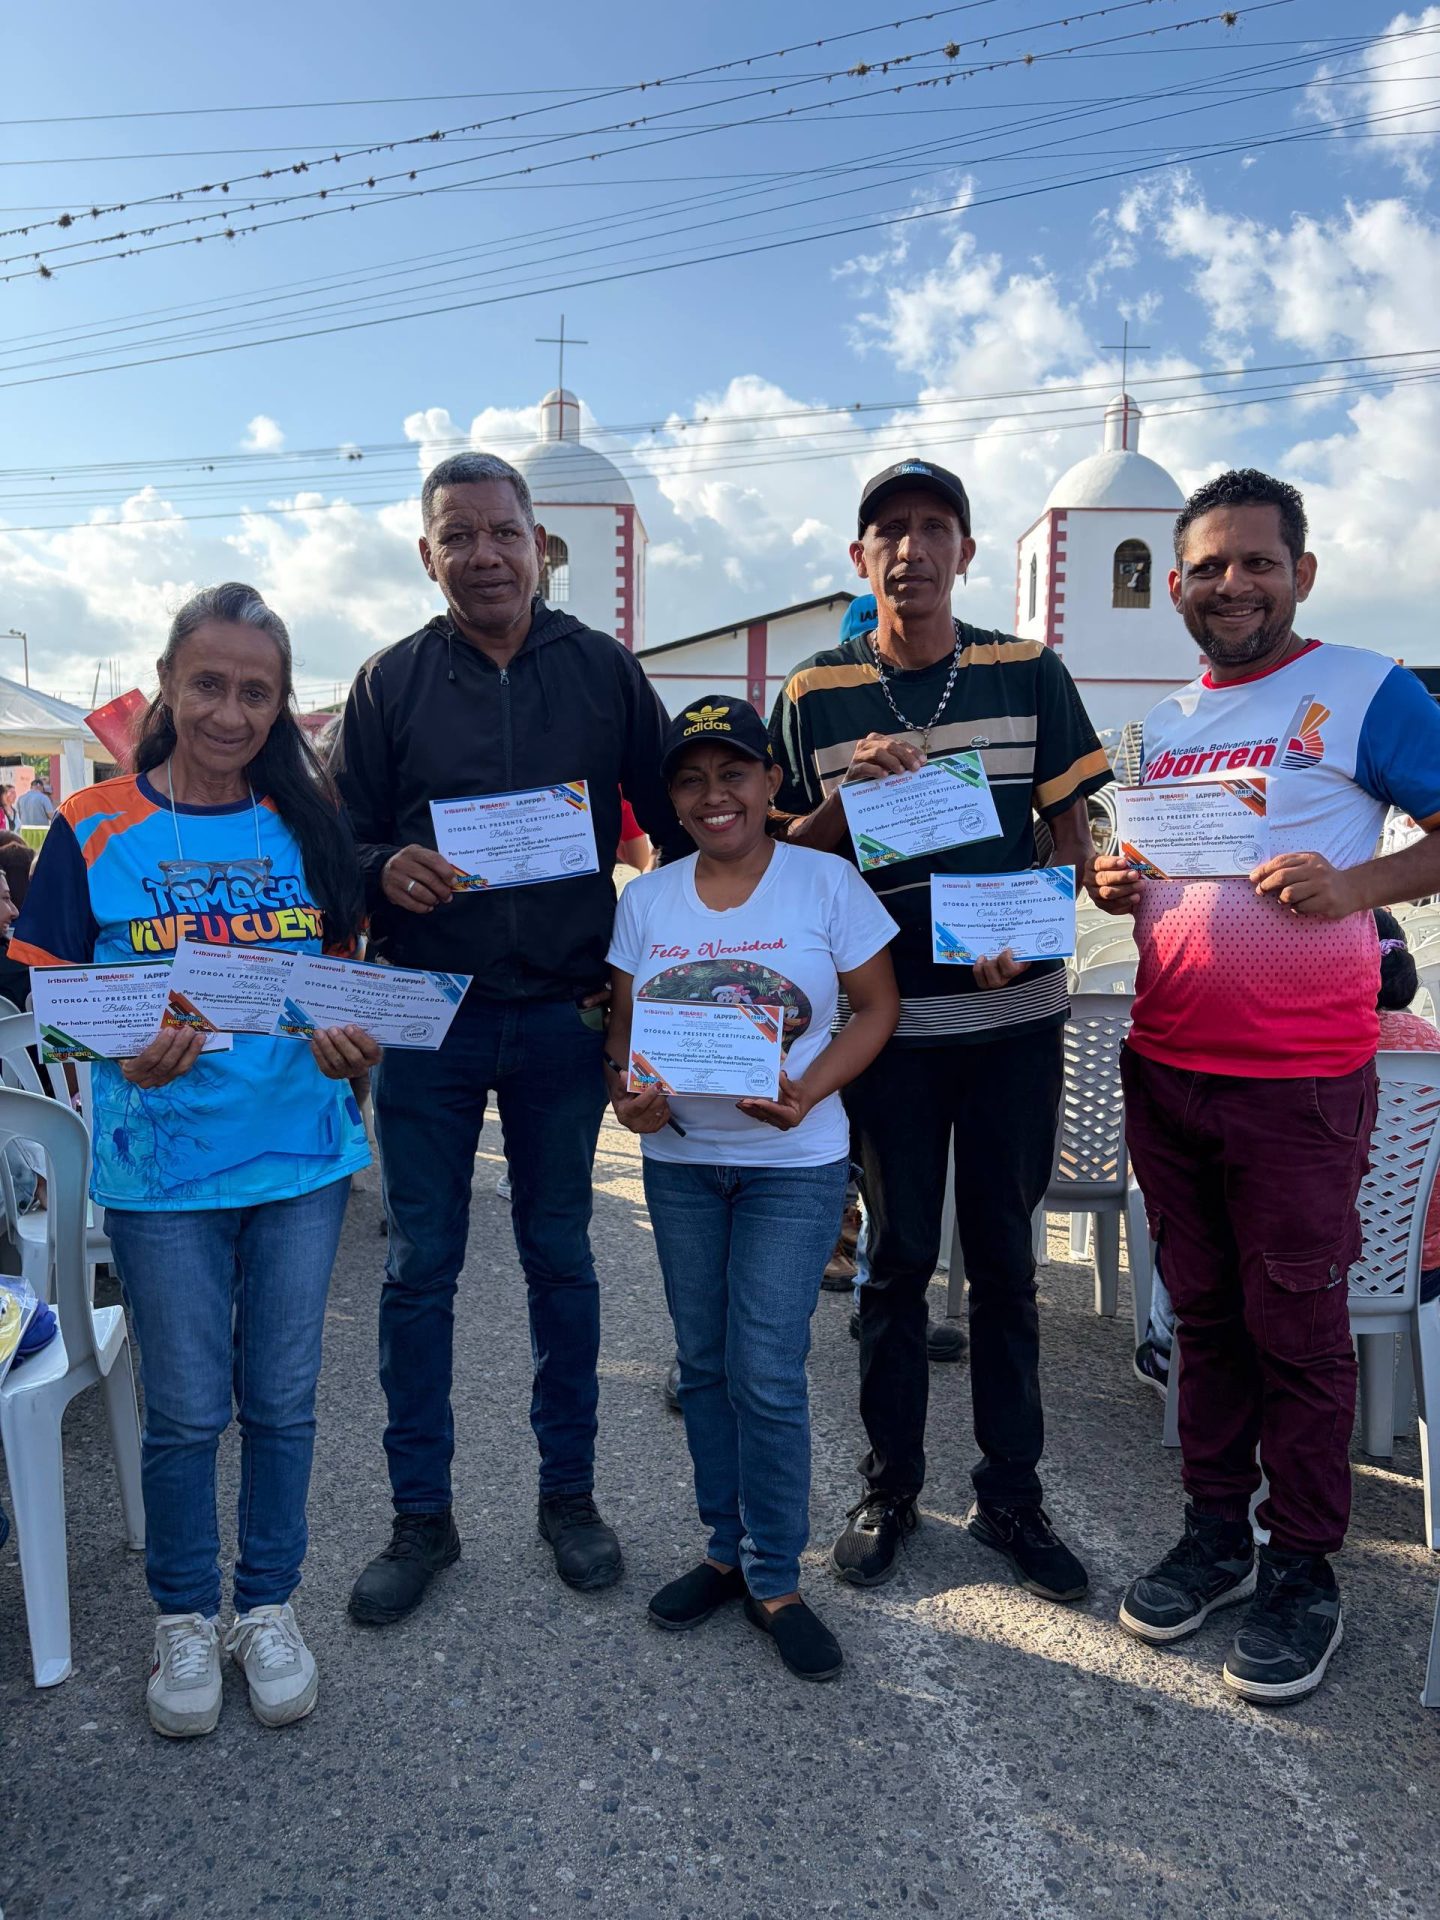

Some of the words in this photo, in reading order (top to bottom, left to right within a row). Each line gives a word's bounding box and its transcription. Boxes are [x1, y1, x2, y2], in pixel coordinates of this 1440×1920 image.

[683, 721, 731, 736] adidas
[1171, 745, 1205, 756] Alcaldía
[1210, 739, 1262, 751] Bolivariana
[1141, 744, 1276, 782] ibarren
[859, 804, 884, 814] OTORGA
[896, 792, 926, 804] PRESENTE
[490, 819, 522, 828] PRESENTE
[526, 812, 570, 822] CERTIFICADO
[891, 818, 920, 828] participado
[934, 809, 946, 817] Taller
[477, 845, 507, 854] participado
[546, 832, 586, 842] Funcionamiento
[142, 876, 305, 915] TAMACA
[1015, 897, 1056, 905] CERTIFICADO
[650, 945, 689, 959] Feliz
[698, 938, 787, 958] Navidad
[189, 969, 224, 977] OTORGA
[215, 993, 252, 1001] participado
[305, 981, 337, 990] OTORGA
[352, 988, 390, 998] PRESENTE
[136, 1002, 162, 1011] Brice
[326, 1005, 361, 1014] participado
